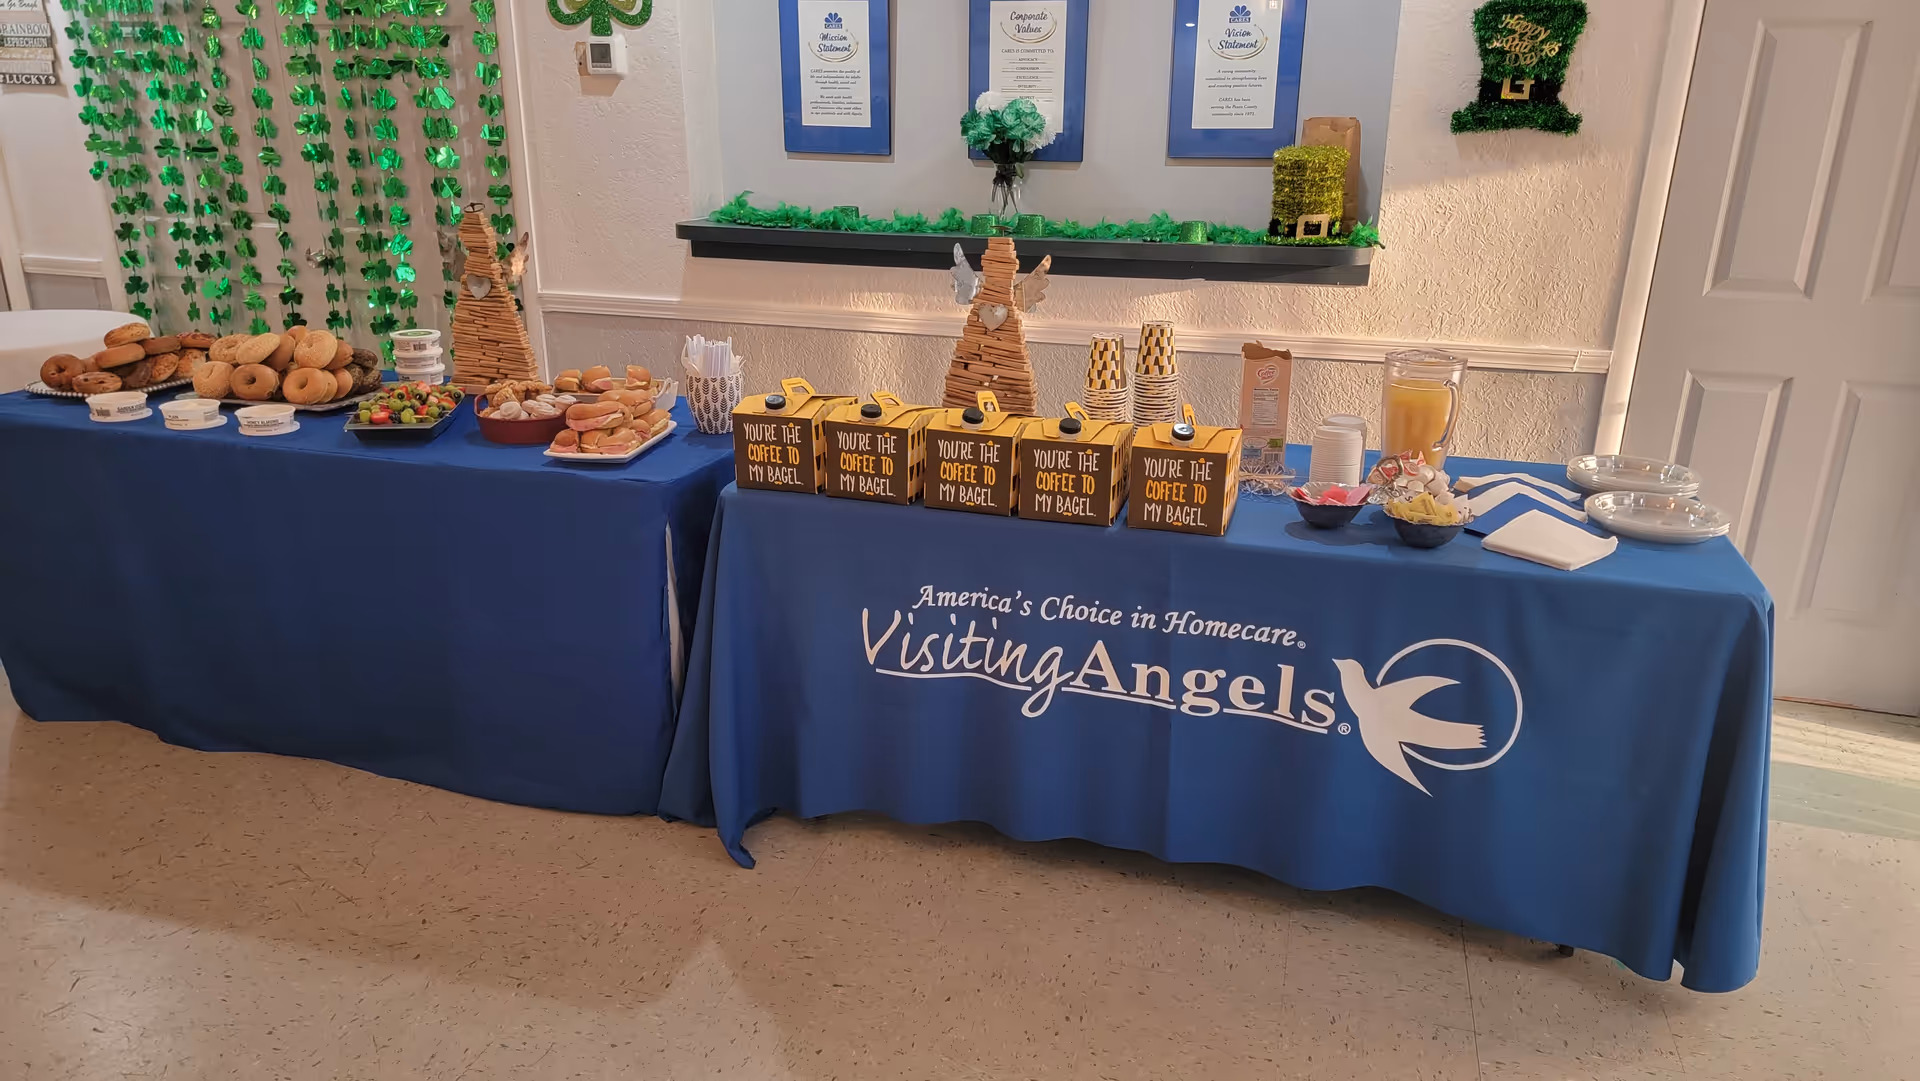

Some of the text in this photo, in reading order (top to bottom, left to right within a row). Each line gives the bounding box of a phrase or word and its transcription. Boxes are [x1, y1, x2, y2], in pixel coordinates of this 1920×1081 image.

[1010, 11, 1048, 23] Corporate
[1498, 14, 1550, 41] Happy
[2, 24, 49, 34] RAINBOW
[819, 33, 848, 41] Mission
[1015, 23, 1042, 33] Values
[1225, 28, 1252, 38] Vision
[817, 43, 851, 52] Statement
[1217, 39, 1258, 50] Statement
[6, 74, 47, 84] LUCKY
[743, 423, 801, 444] YOU'RE THE
[837, 431, 897, 454] YOU'RE THE
[748, 444, 800, 465] COFFEE TO
[938, 440, 1000, 463] YOU'RE THE
[1034, 449, 1100, 472] YOU'RE THE
[749, 464, 763, 482] MY
[840, 452, 894, 475] COFFEE TO
[940, 460, 996, 485] COFFEE TO
[1144, 457, 1214, 481] YOU'RE THE
[840, 474, 855, 492] MY
[939, 483, 955, 502] MY
[1036, 471, 1095, 494] COFFEE TO
[1145, 479, 1207, 505] COFFEE TO
[1035, 494, 1052, 513] MY
[1144, 502, 1161, 523] MY
[912, 585, 1033, 616] America's
[1040, 595, 1123, 626] Choice
[1131, 605, 1156, 630] in
[862, 607, 1074, 718] Visiting
